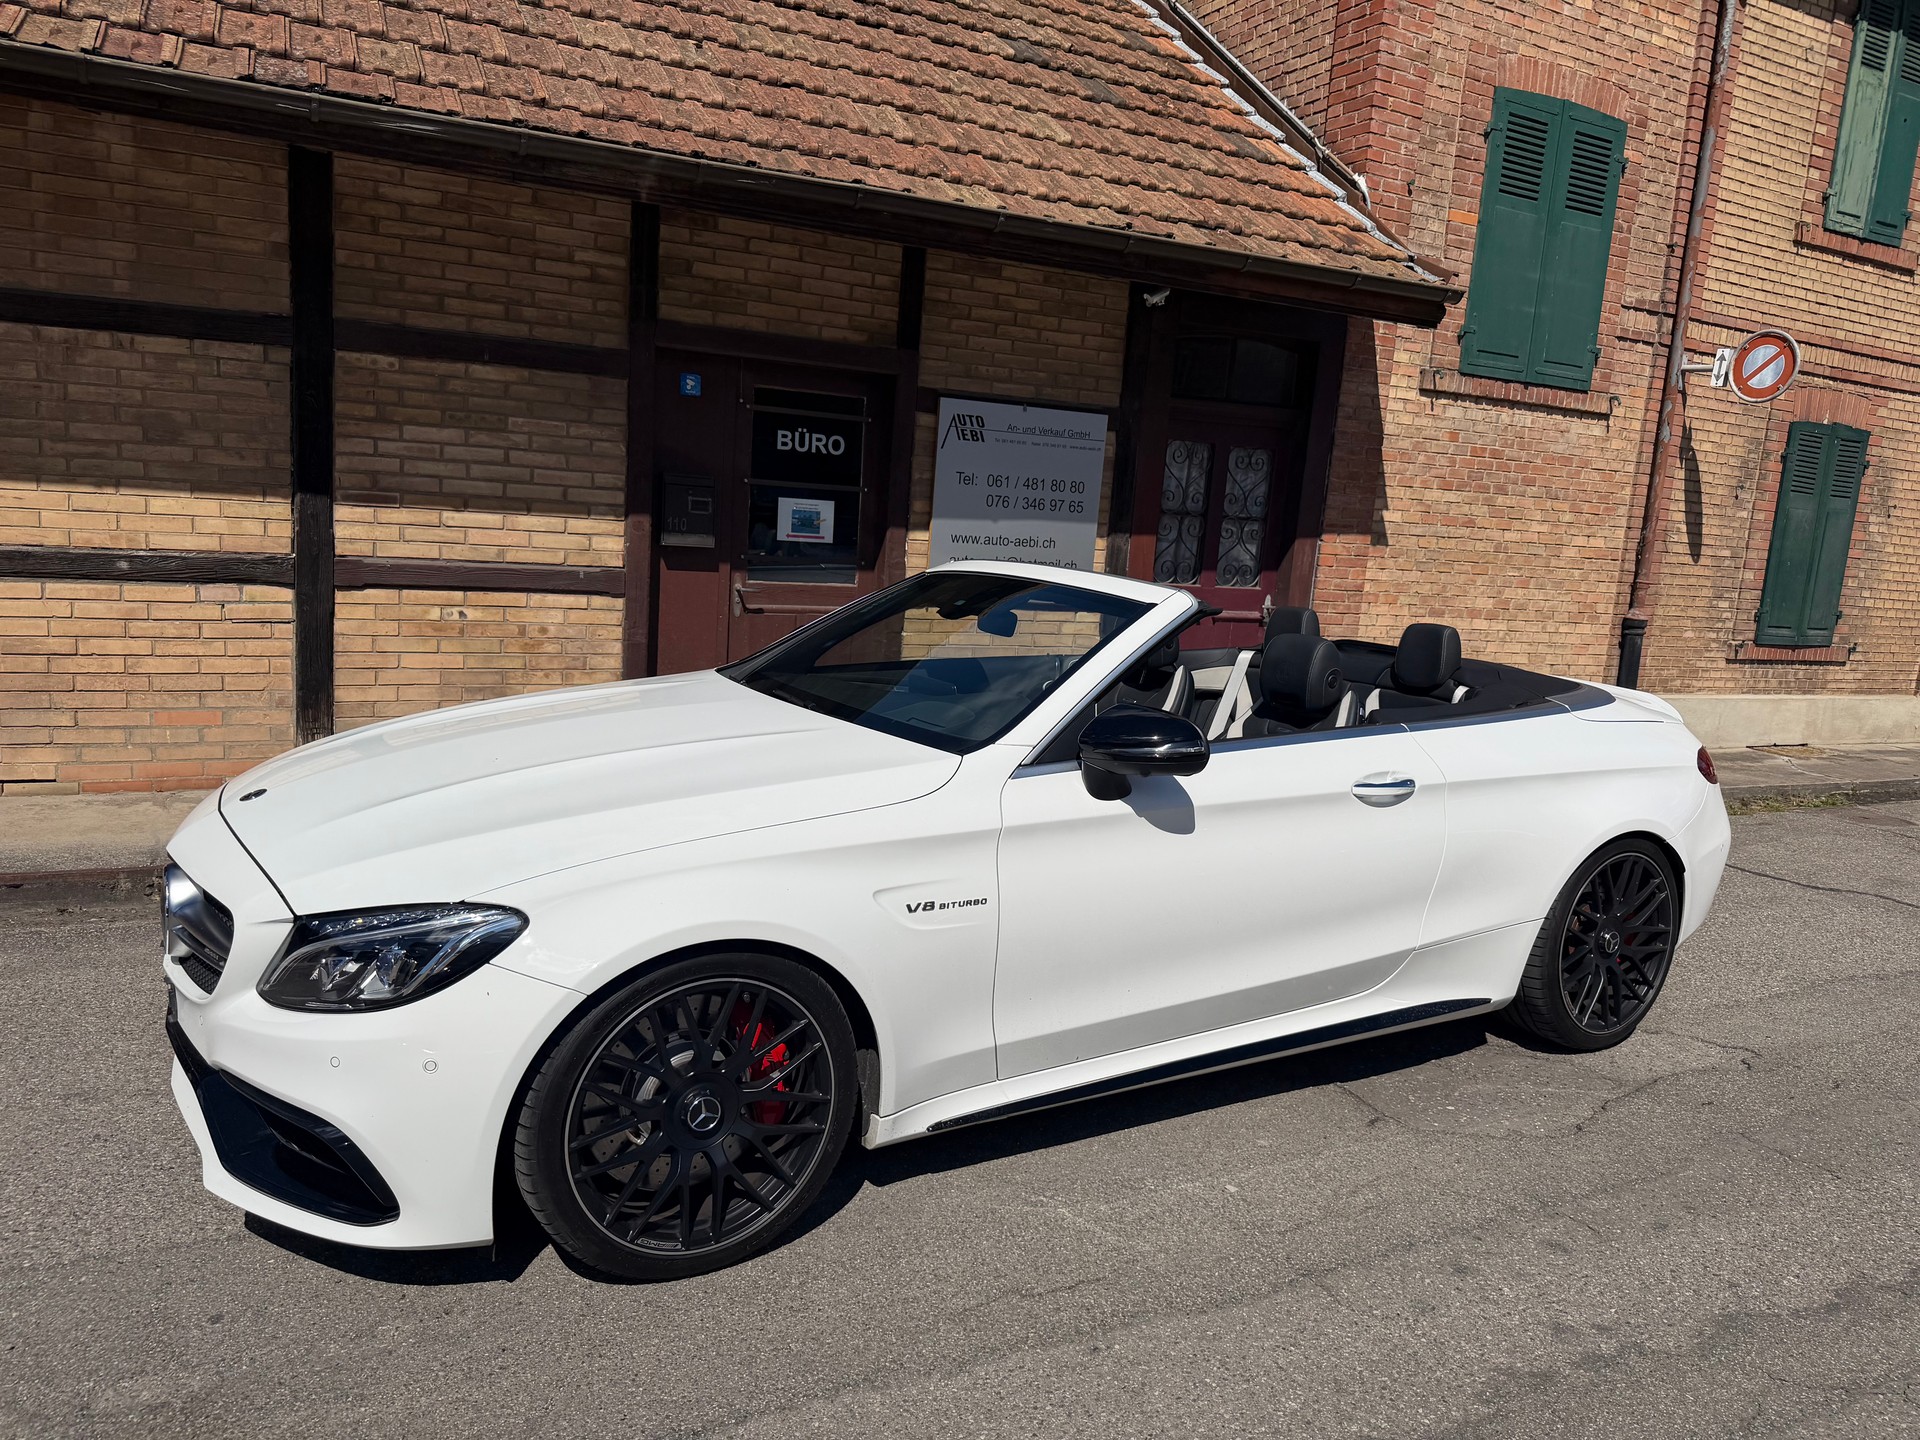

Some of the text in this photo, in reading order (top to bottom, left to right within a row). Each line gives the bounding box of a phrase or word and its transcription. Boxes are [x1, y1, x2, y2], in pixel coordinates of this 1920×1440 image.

[1006, 423, 1091, 439] An- und Verkauf GmbH
[777, 427, 845, 455] BÜRO
[956, 471, 1085, 494] Tel: 061 / 481 80 80
[986, 494, 1084, 513] 076 / 346 97 65
[667, 516, 687, 531] 110
[950, 533, 1056, 549] www.auto-aebi.ch
[905, 898, 988, 914] V8 BITURBO
